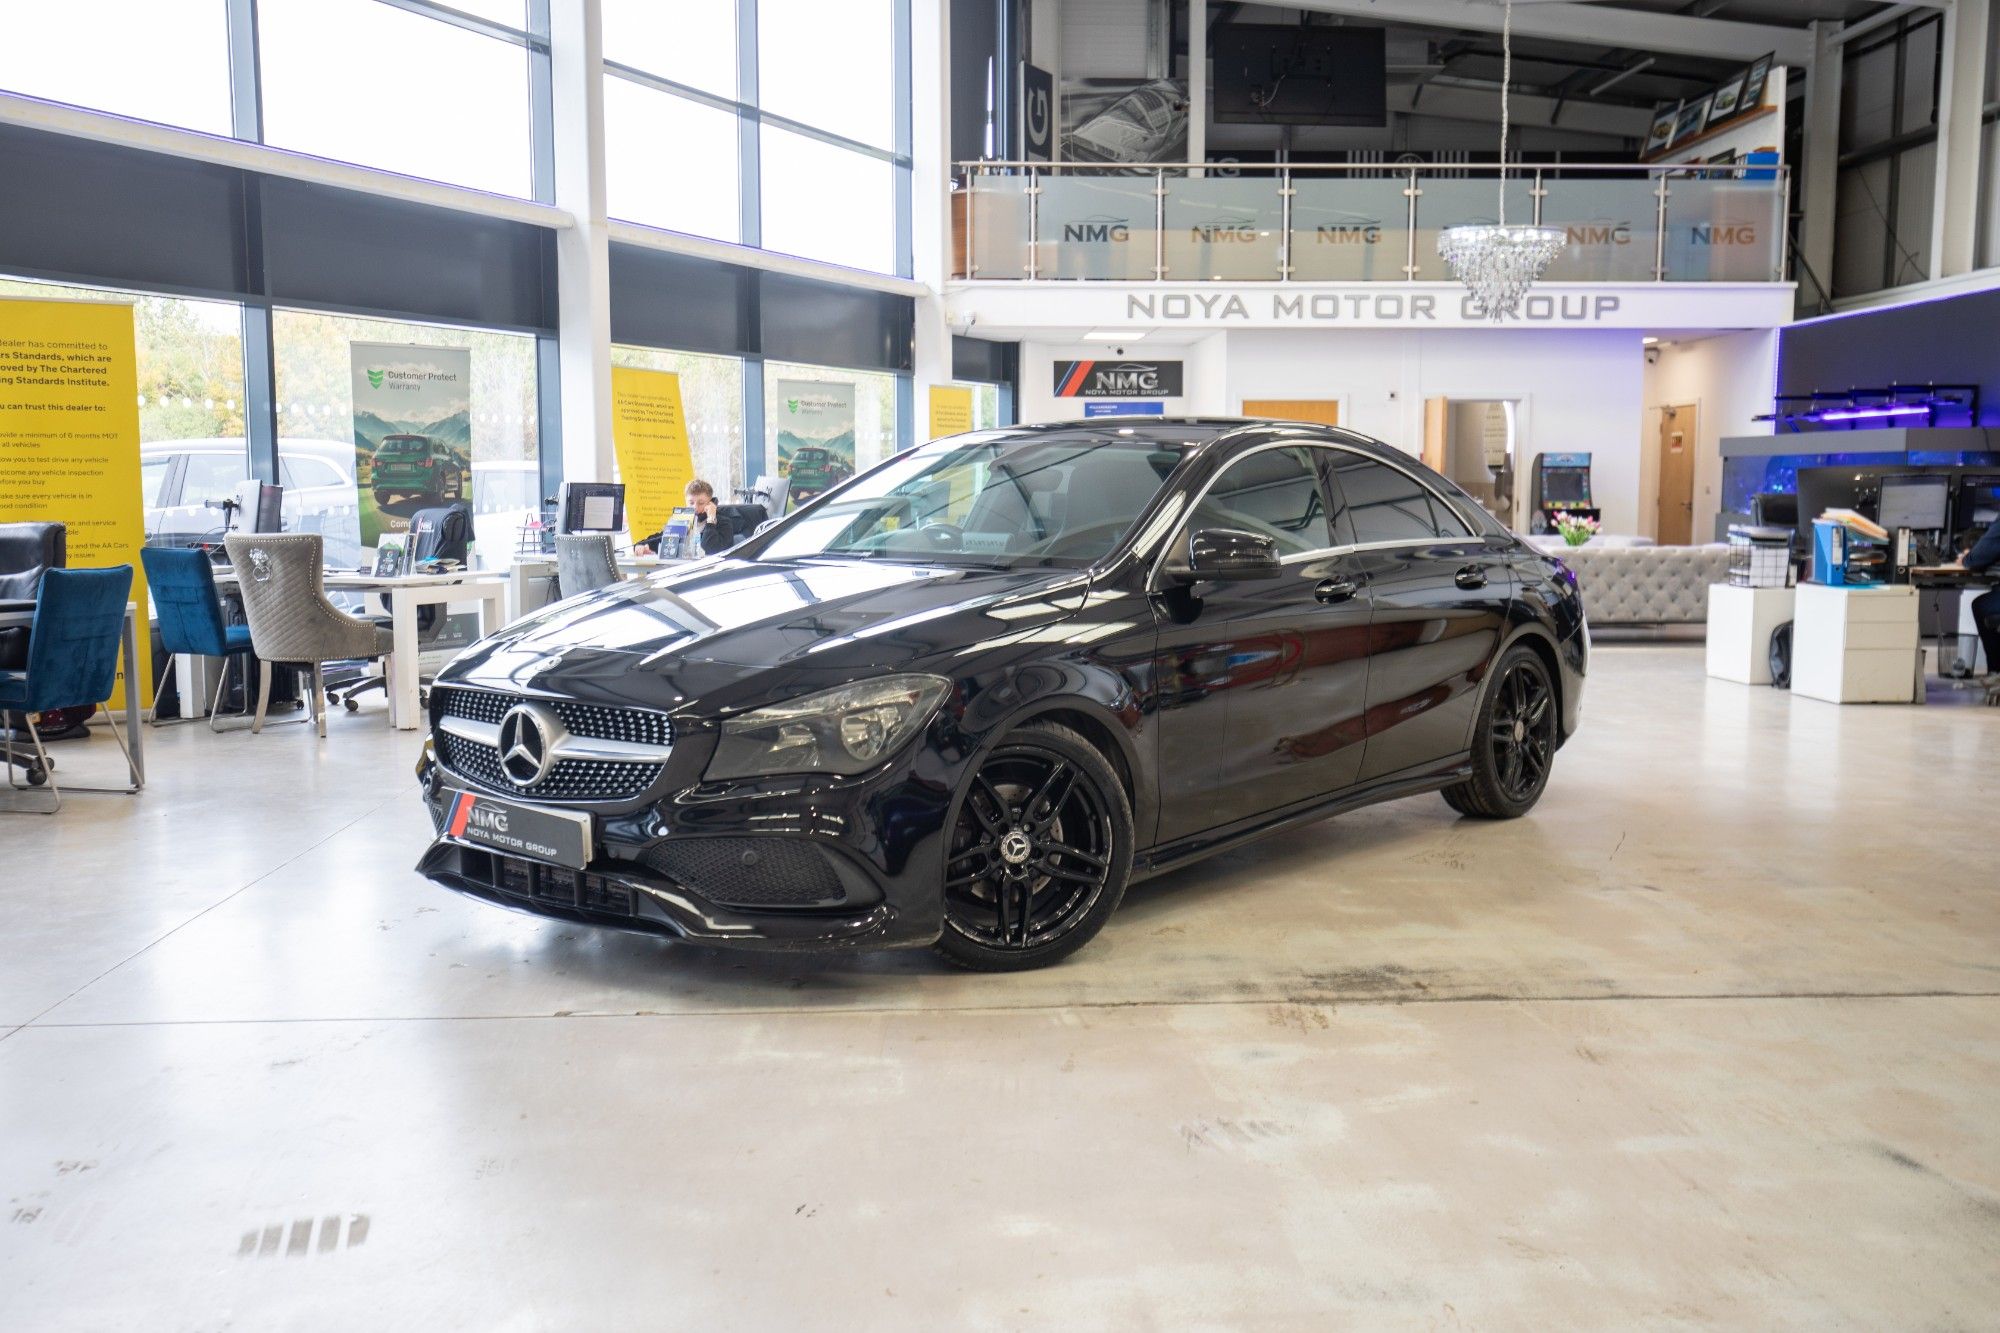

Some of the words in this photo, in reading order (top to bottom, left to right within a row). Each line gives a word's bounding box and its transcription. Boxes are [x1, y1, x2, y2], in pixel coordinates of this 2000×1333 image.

[1064, 224, 1129, 243] NMG
[1191, 225, 1257, 243] NMG
[1317, 226, 1382, 244] NMG
[1691, 227, 1756, 245] NMG
[1127, 294, 1250, 319] NOYA
[1273, 294, 1436, 320] MOTOR
[1461, 295, 1621, 320] GROUP
[28, 340, 45, 348] has
[47, 342, 96, 350] committed
[12, 352, 65, 361] Standards,
[67, 354, 95, 362] which
[26, 365, 38, 373] by
[39, 364, 57, 372] The
[60, 365, 107, 374] Chartered
[388, 371, 426, 380] Customer
[428, 372, 457, 381] Protect
[16, 377, 65, 385] Standards
[67, 378, 110, 386] Institute.
[1096, 372, 1159, 390] NMG
[48, 403, 64, 411] this
[68, 469, 104, 477] inspection
[467, 806, 508, 832] NMG
[467, 827, 490, 840] NOYA
[492, 833, 524, 848] MOTOR
[525, 842, 557, 857] GROUP
